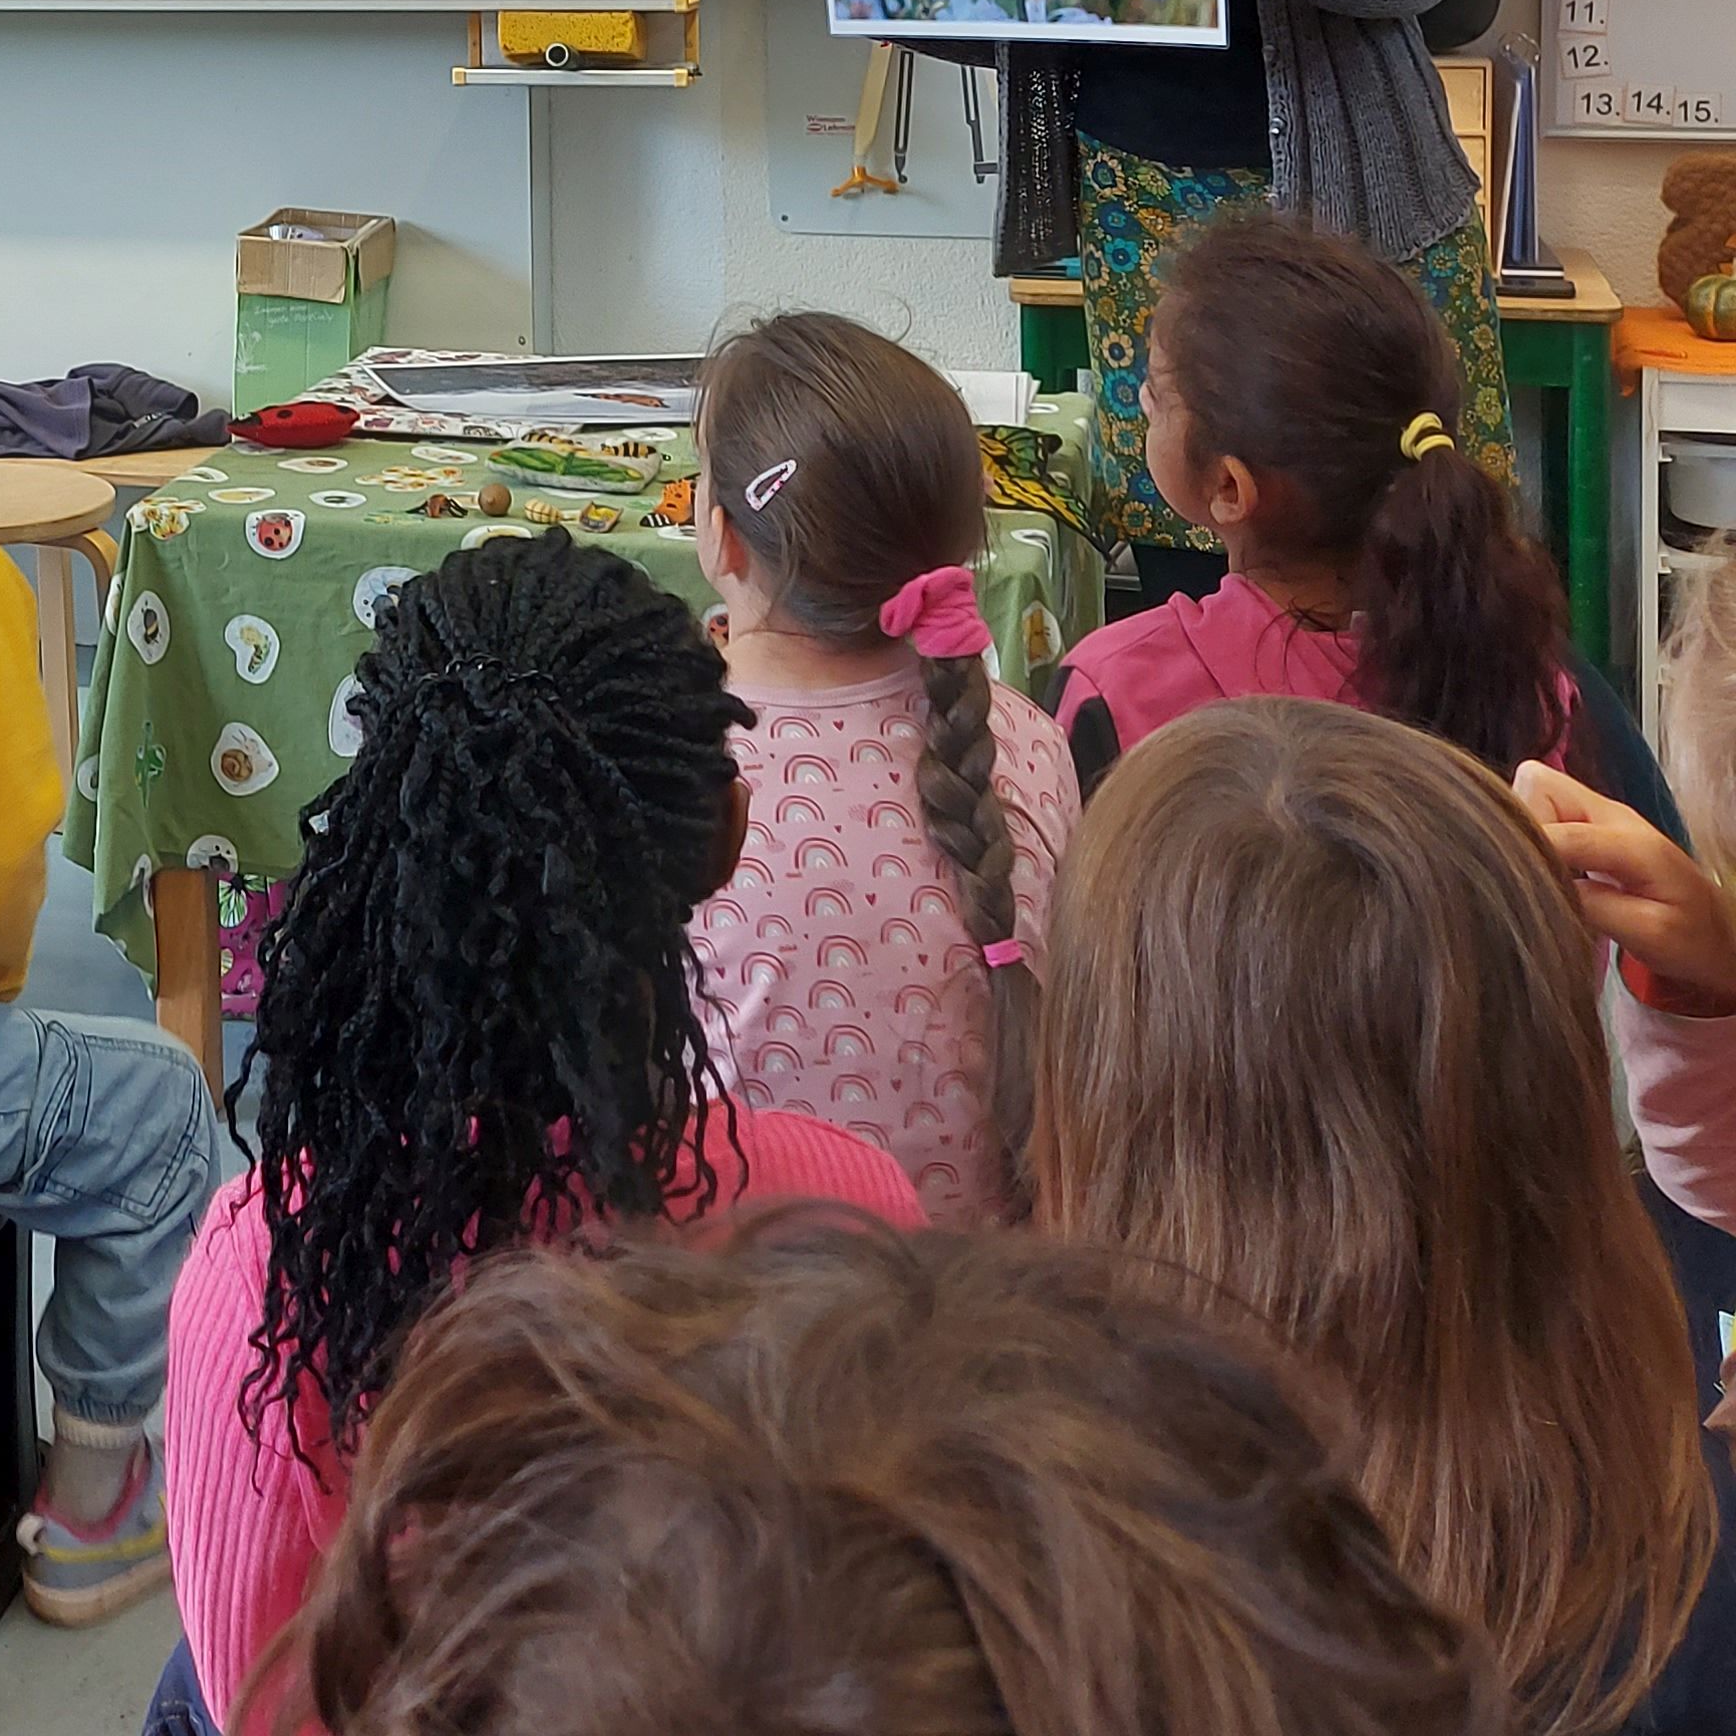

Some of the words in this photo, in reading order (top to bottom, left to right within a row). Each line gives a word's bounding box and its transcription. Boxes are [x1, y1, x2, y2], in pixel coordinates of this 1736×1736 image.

[1564, 0, 1606, 26] 11.
[1566, 44, 1610, 70] 12.
[1579, 91, 1622, 117] 13.
[1630, 90, 1672, 116] 14.
[1677, 99, 1721, 124] 15.
